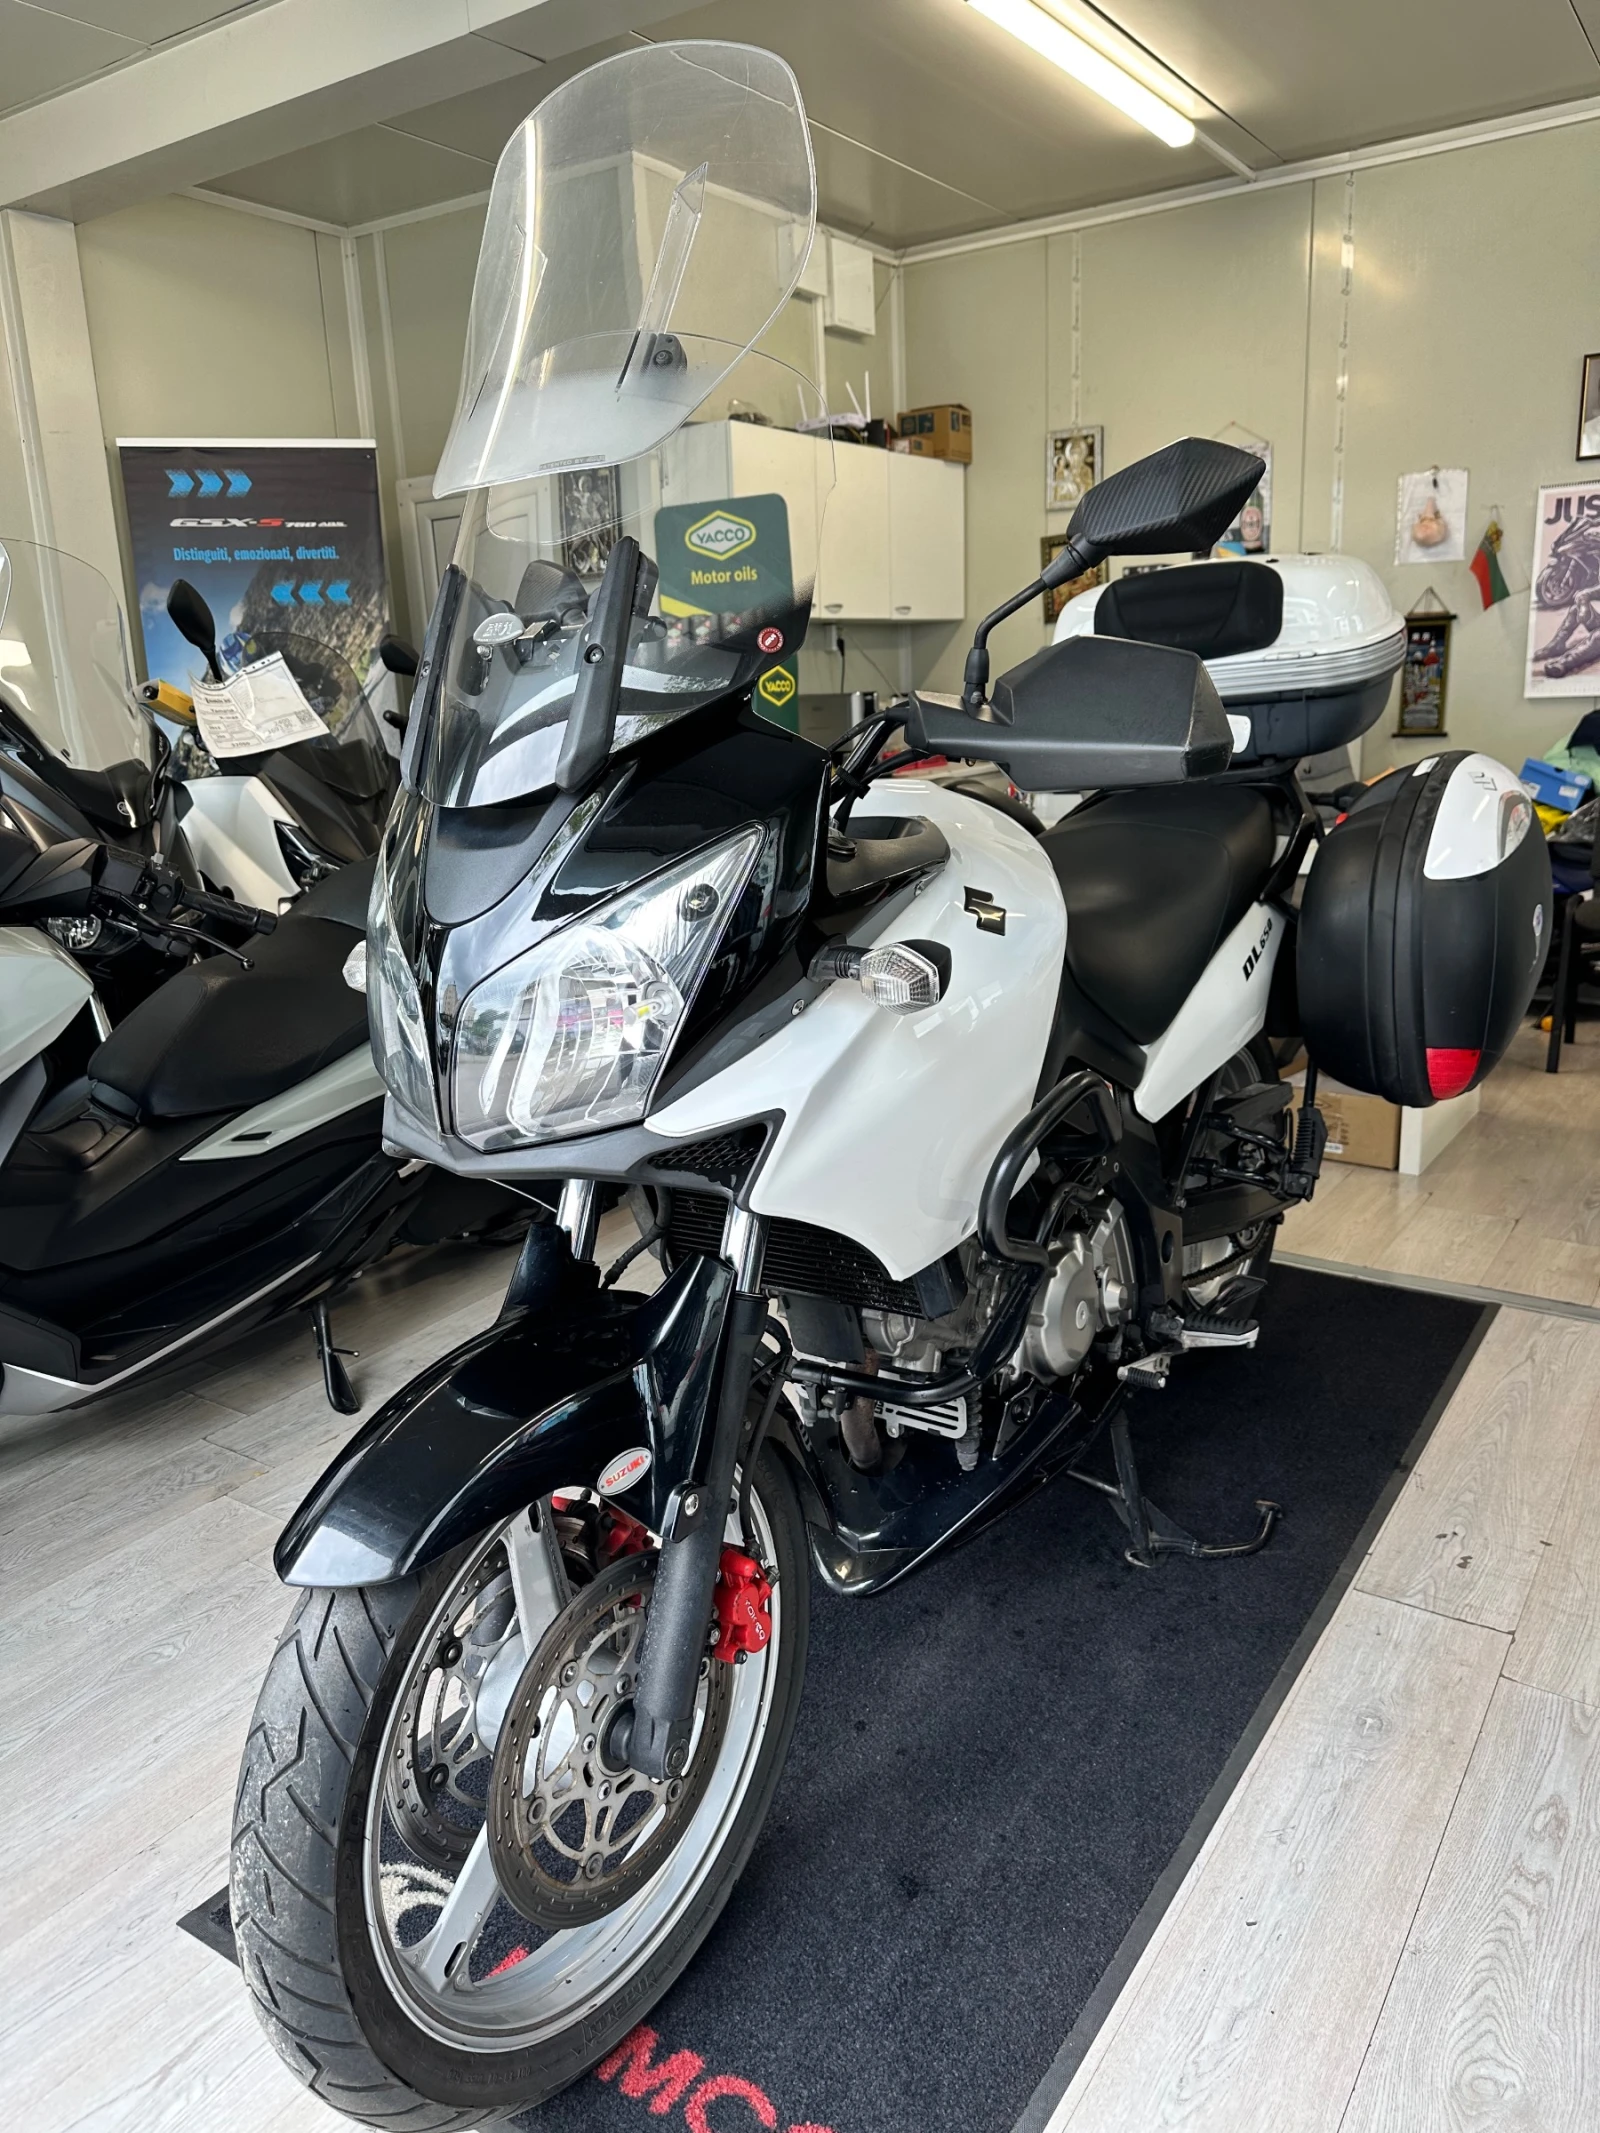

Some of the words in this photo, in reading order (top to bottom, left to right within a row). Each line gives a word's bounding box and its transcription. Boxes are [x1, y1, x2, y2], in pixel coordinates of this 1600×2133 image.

[697, 527, 745, 545] YACCO
[173, 546, 232, 564] Distinguiti,
[234, 546, 294, 562] emozionati,
[296, 545, 340, 561] divertiti.
[691, 569, 731, 585] Motor
[734, 566, 758, 582] oils
[765, 680, 791, 692] YACCO
[605, 1455, 646, 1487] SUZUKI
